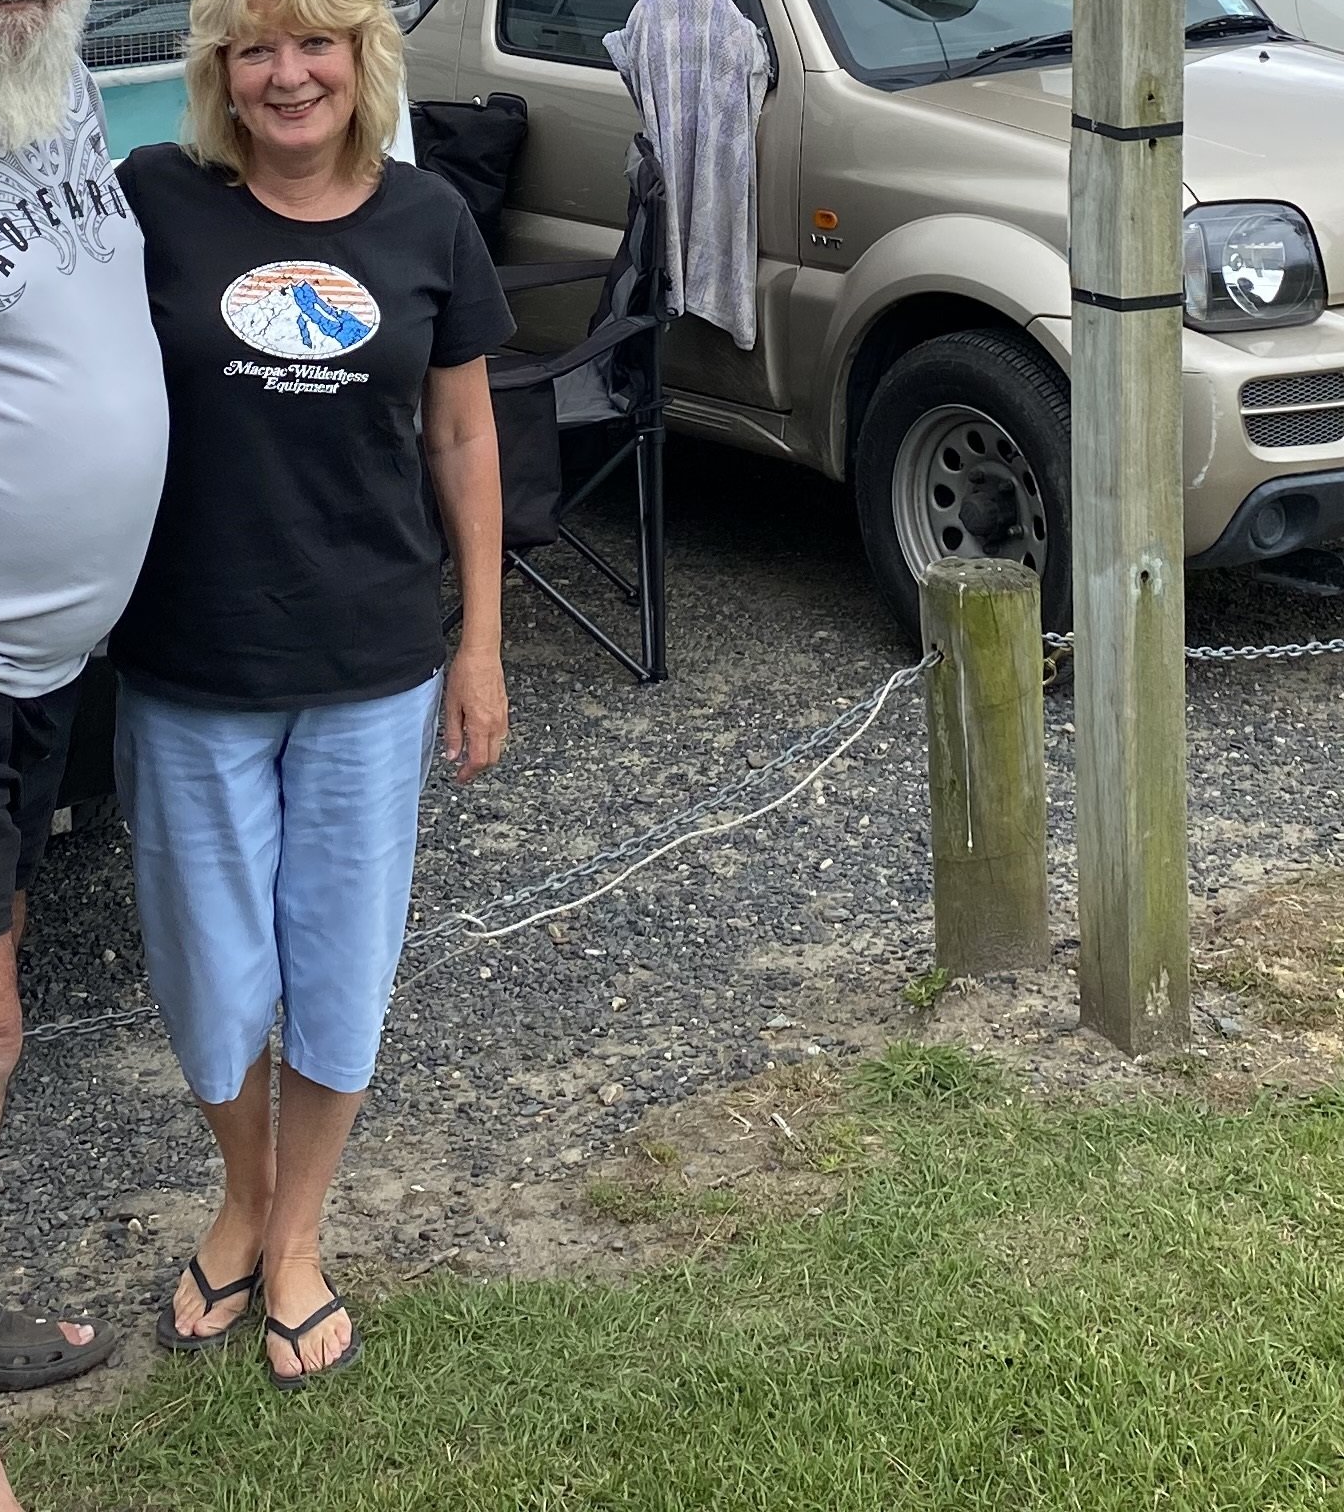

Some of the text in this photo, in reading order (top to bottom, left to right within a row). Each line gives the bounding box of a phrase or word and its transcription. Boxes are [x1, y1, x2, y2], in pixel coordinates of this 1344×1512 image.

[223, 361, 369, 384] Macpac Wilderness
[264, 377, 339, 394] Equipment
